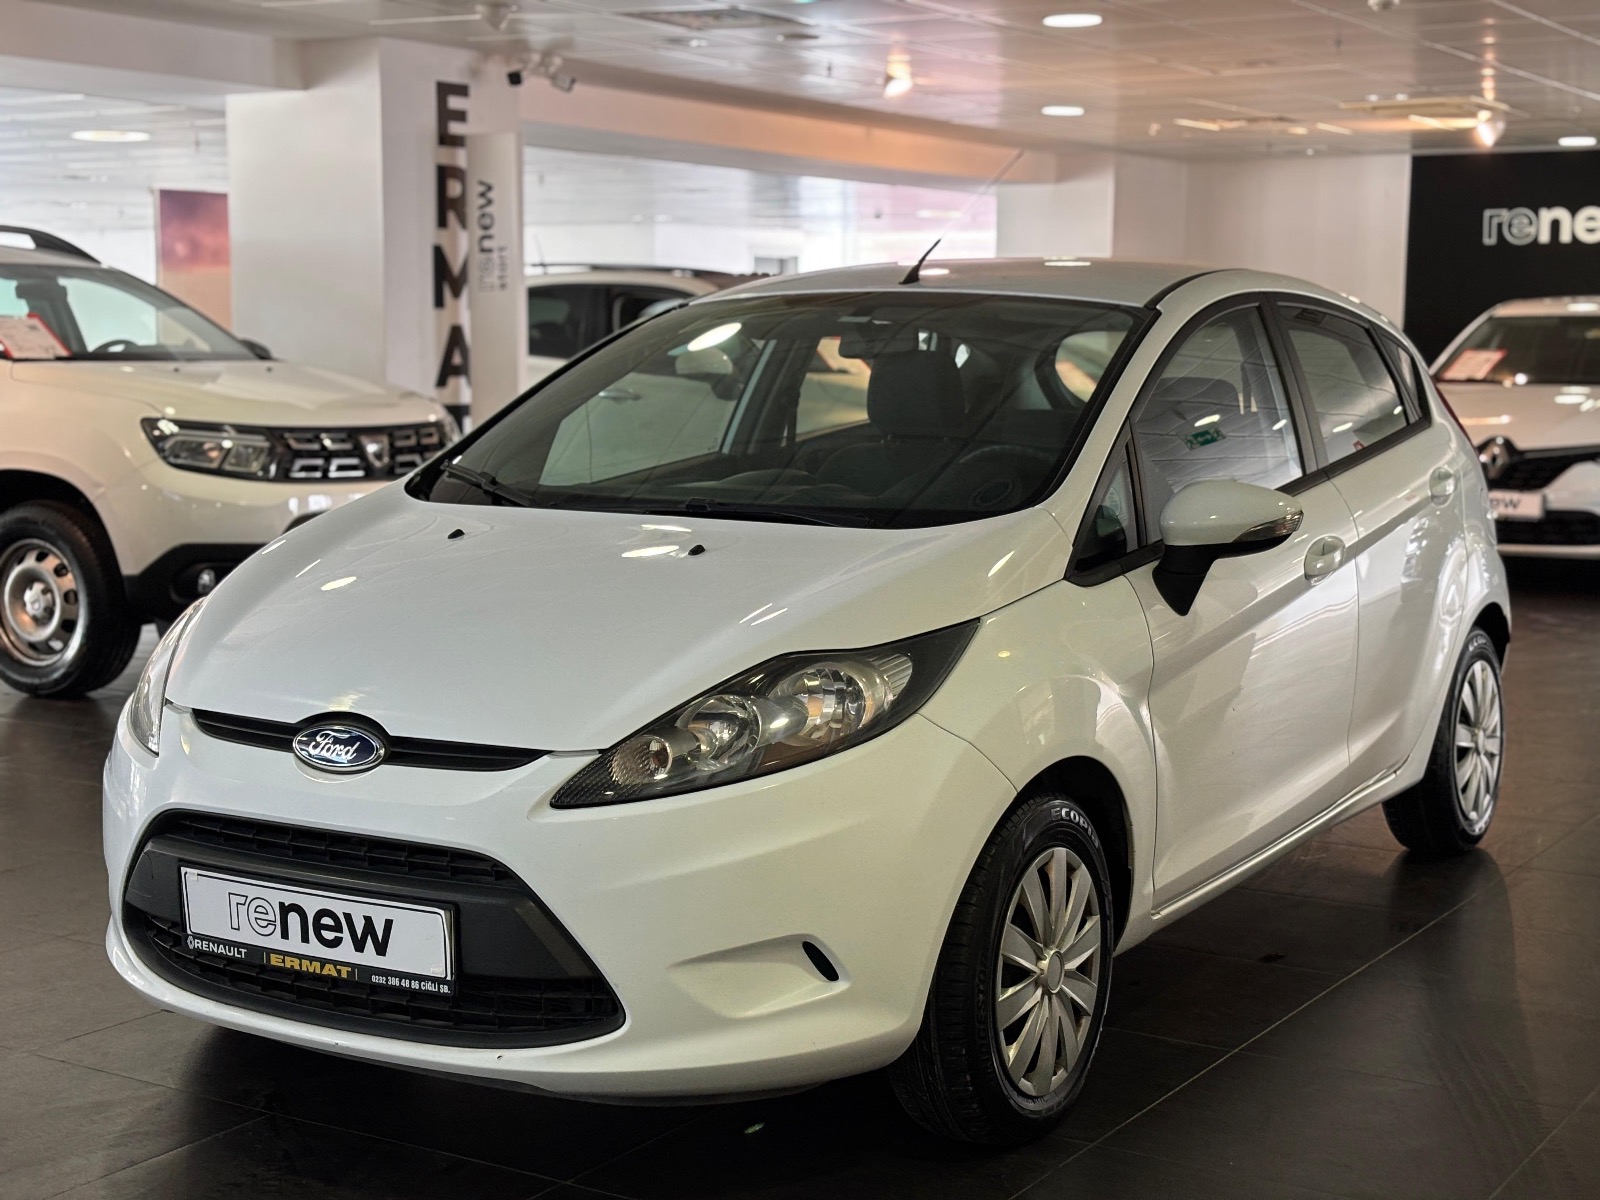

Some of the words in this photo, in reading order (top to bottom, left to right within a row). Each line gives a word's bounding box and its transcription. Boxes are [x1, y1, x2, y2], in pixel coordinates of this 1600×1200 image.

[308, 730, 361, 760] Ford
[228, 892, 394, 957] renew
[194, 940, 247, 958] RENAULT
[269, 953, 352, 979] ERMAT
[371, 974, 387, 985] 0232
